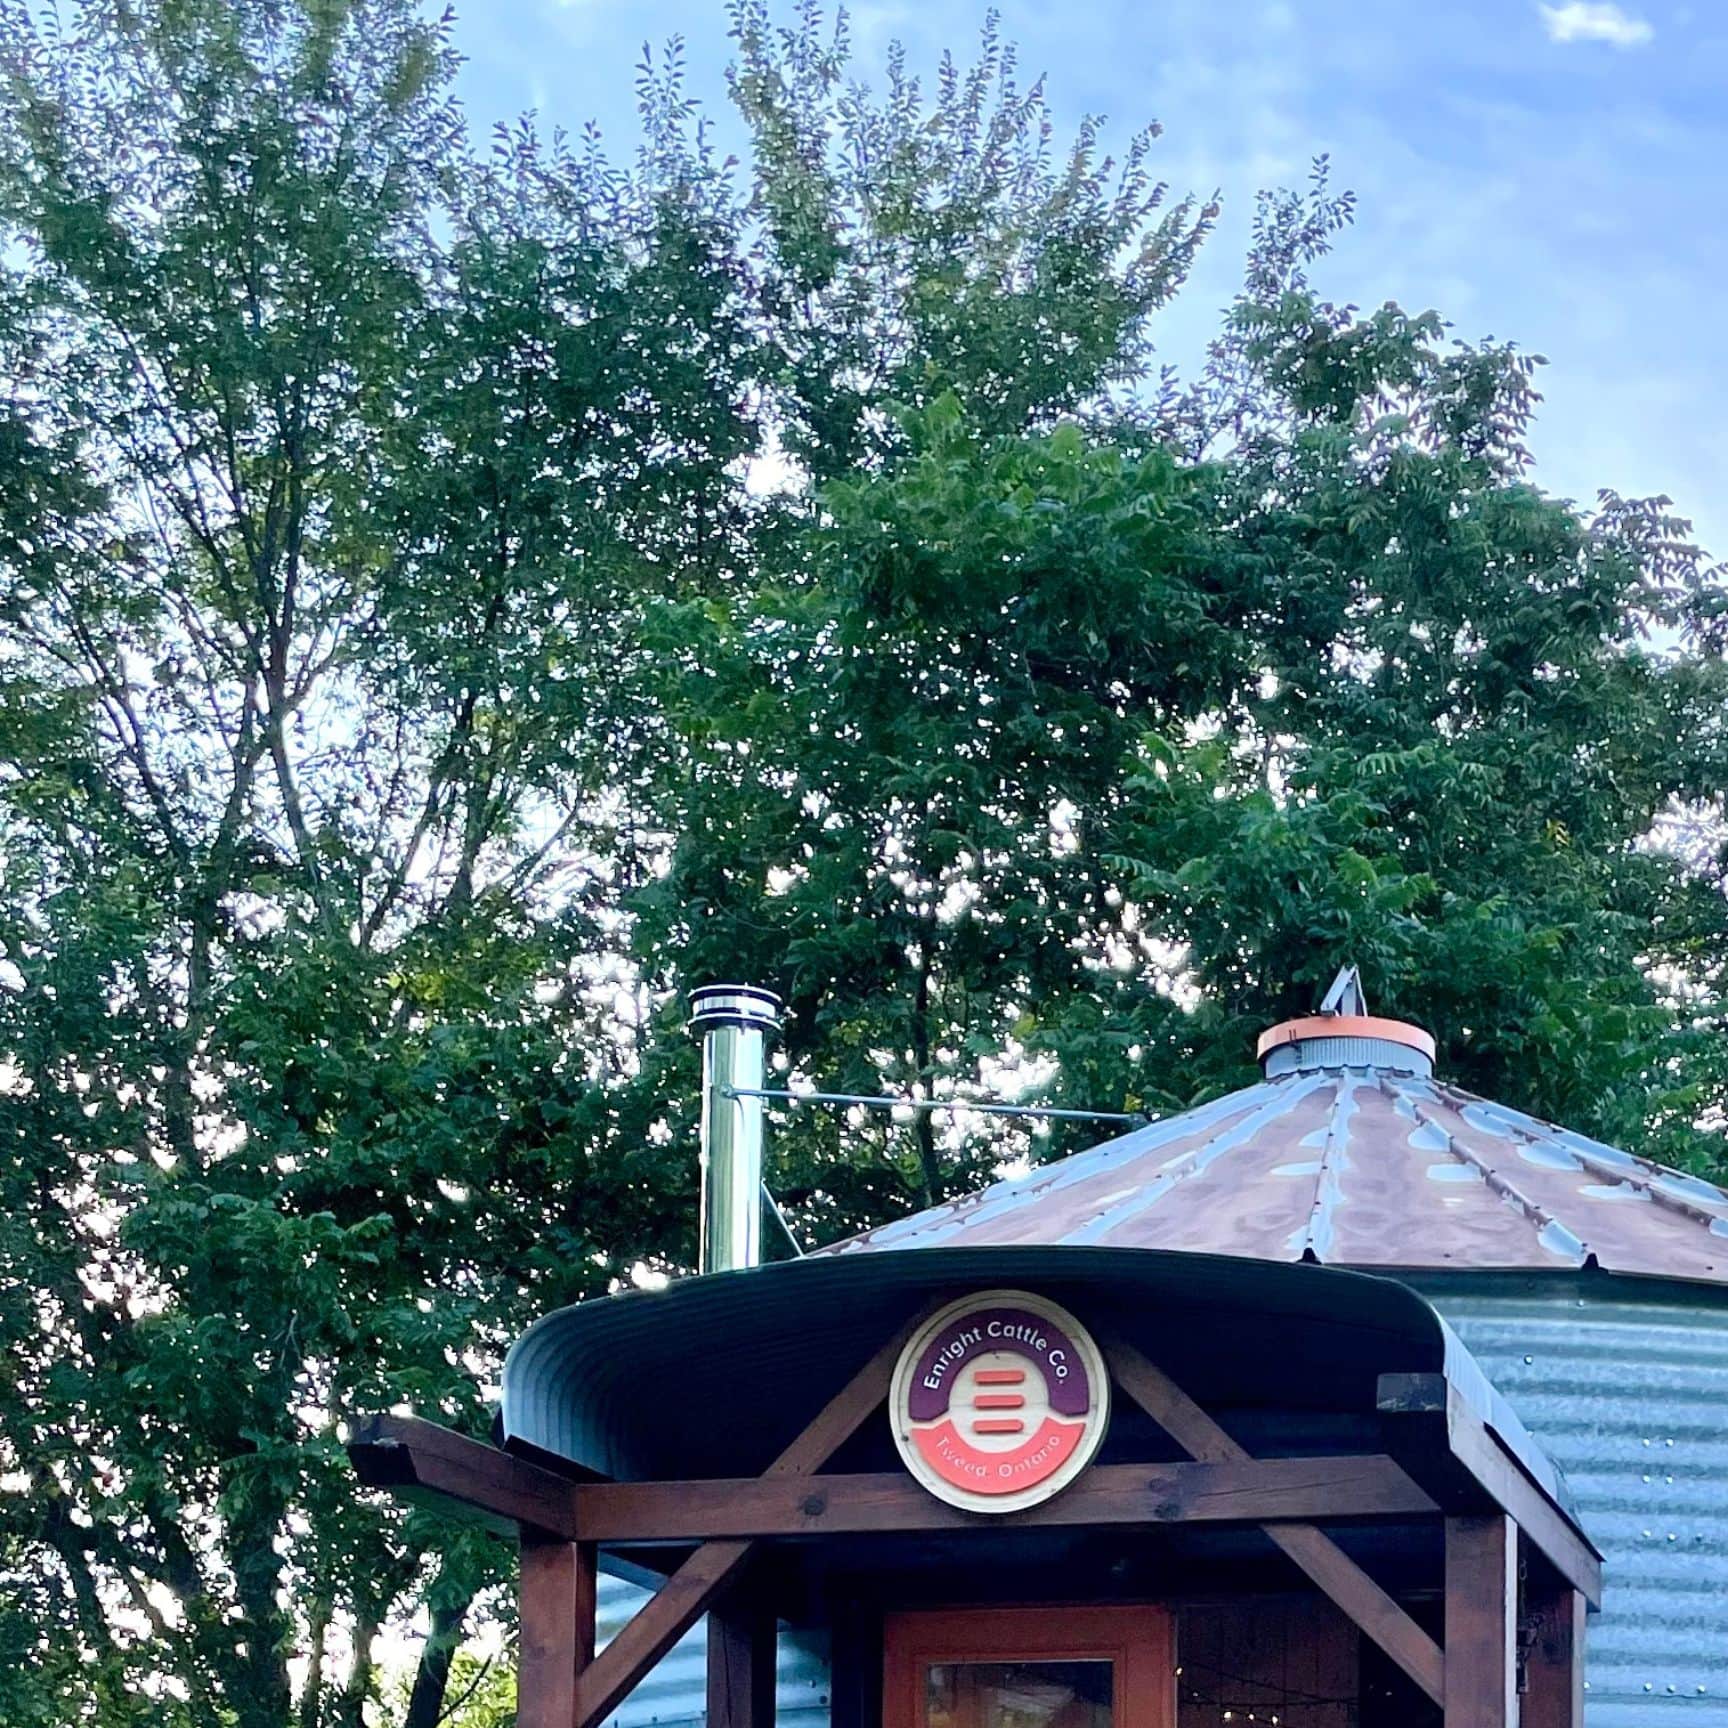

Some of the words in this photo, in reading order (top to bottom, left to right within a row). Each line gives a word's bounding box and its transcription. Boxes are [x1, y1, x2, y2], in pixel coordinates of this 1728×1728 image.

[924, 1327, 982, 1389] Enright
[987, 1321, 1047, 1351] Cattle
[1049, 1350, 1069, 1384] Co.
[999, 1436, 1060, 1478] Ontario
